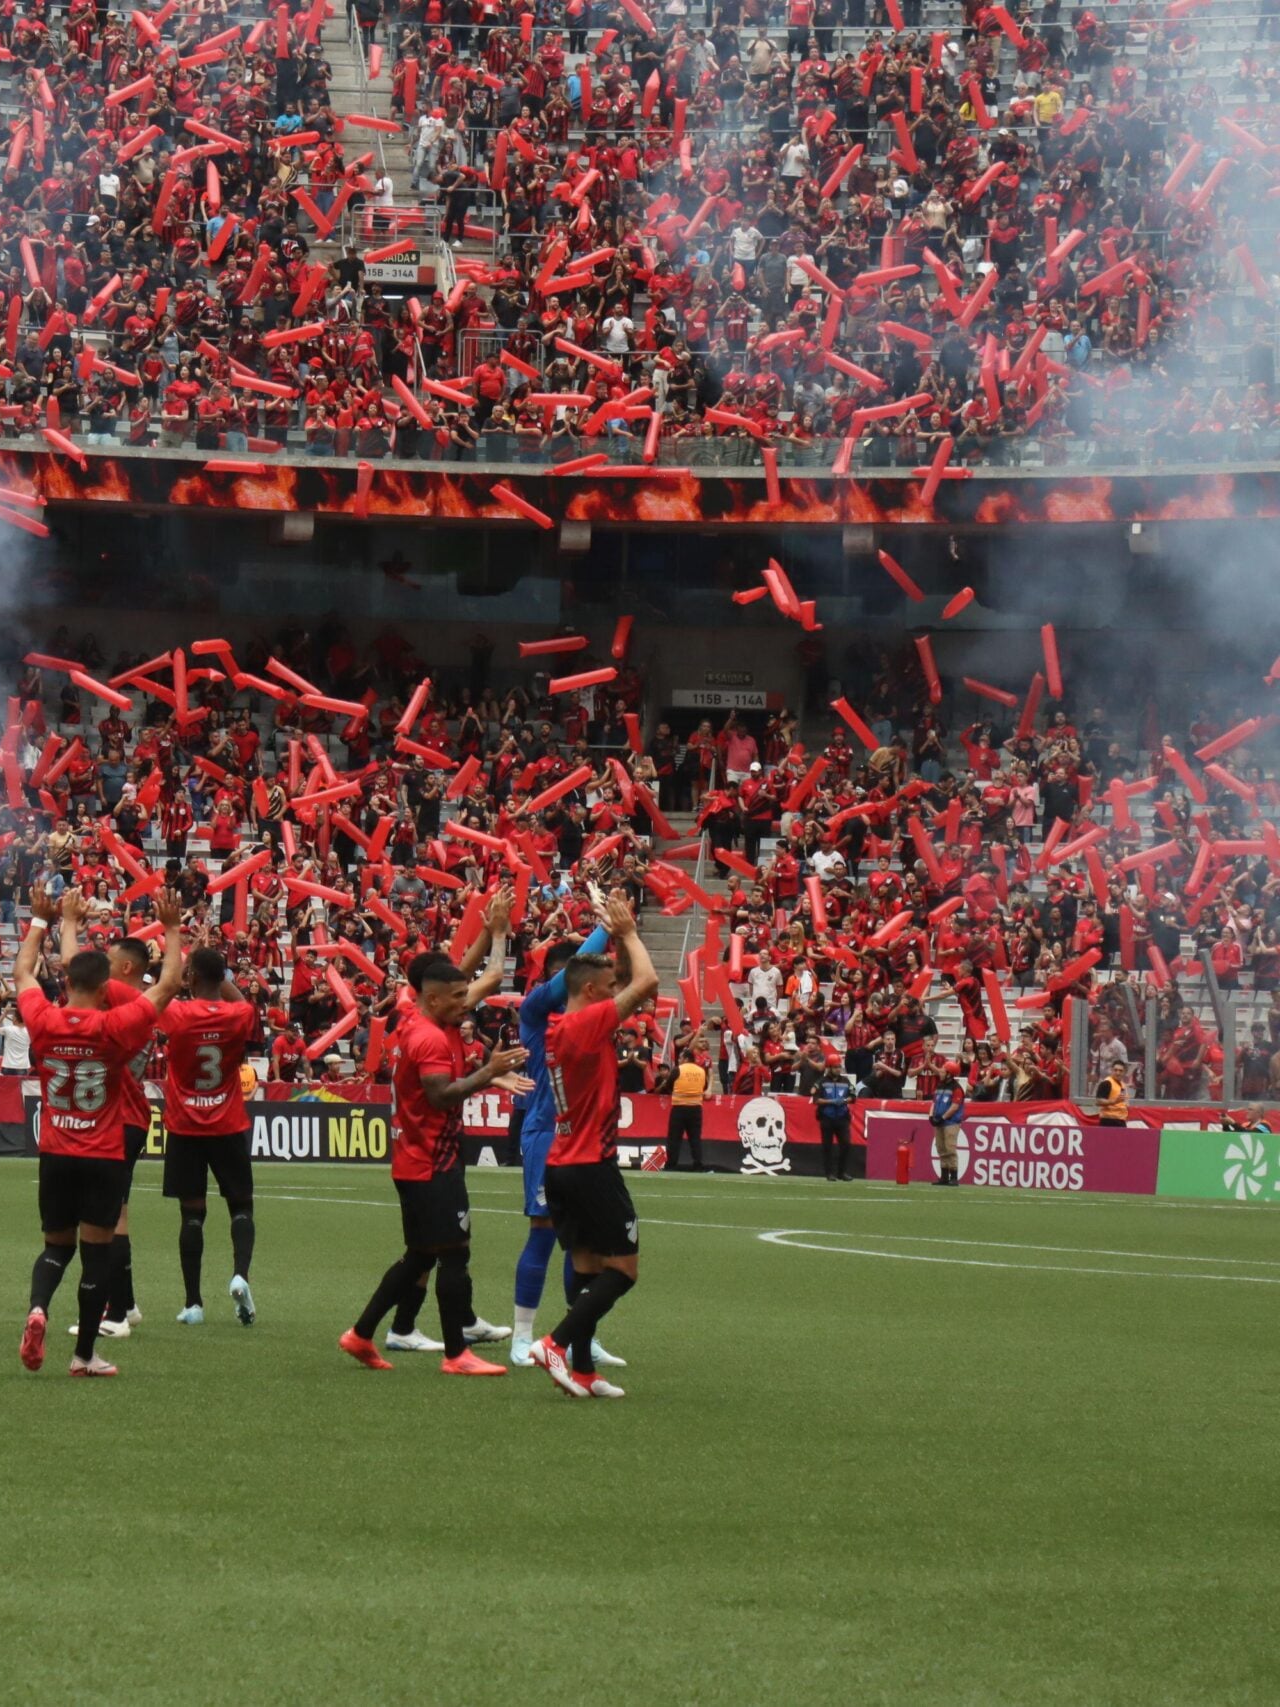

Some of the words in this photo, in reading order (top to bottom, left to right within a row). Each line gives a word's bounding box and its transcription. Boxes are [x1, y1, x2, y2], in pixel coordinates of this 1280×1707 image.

[392, 269, 414, 278] 314A
[693, 693, 722, 705] 115B
[735, 695, 764, 706] 114A
[53, 1045, 94, 1057] CUELLO
[43, 1056, 107, 1112] 28
[195, 1045, 224, 1091] 3
[194, 1093, 228, 1108] inter
[251, 1115, 320, 1161] AQUI
[328, 1108, 387, 1159] NÃO
[974, 1124, 1084, 1156] SANCOR
[973, 1158, 1084, 1191] SEGUROS
